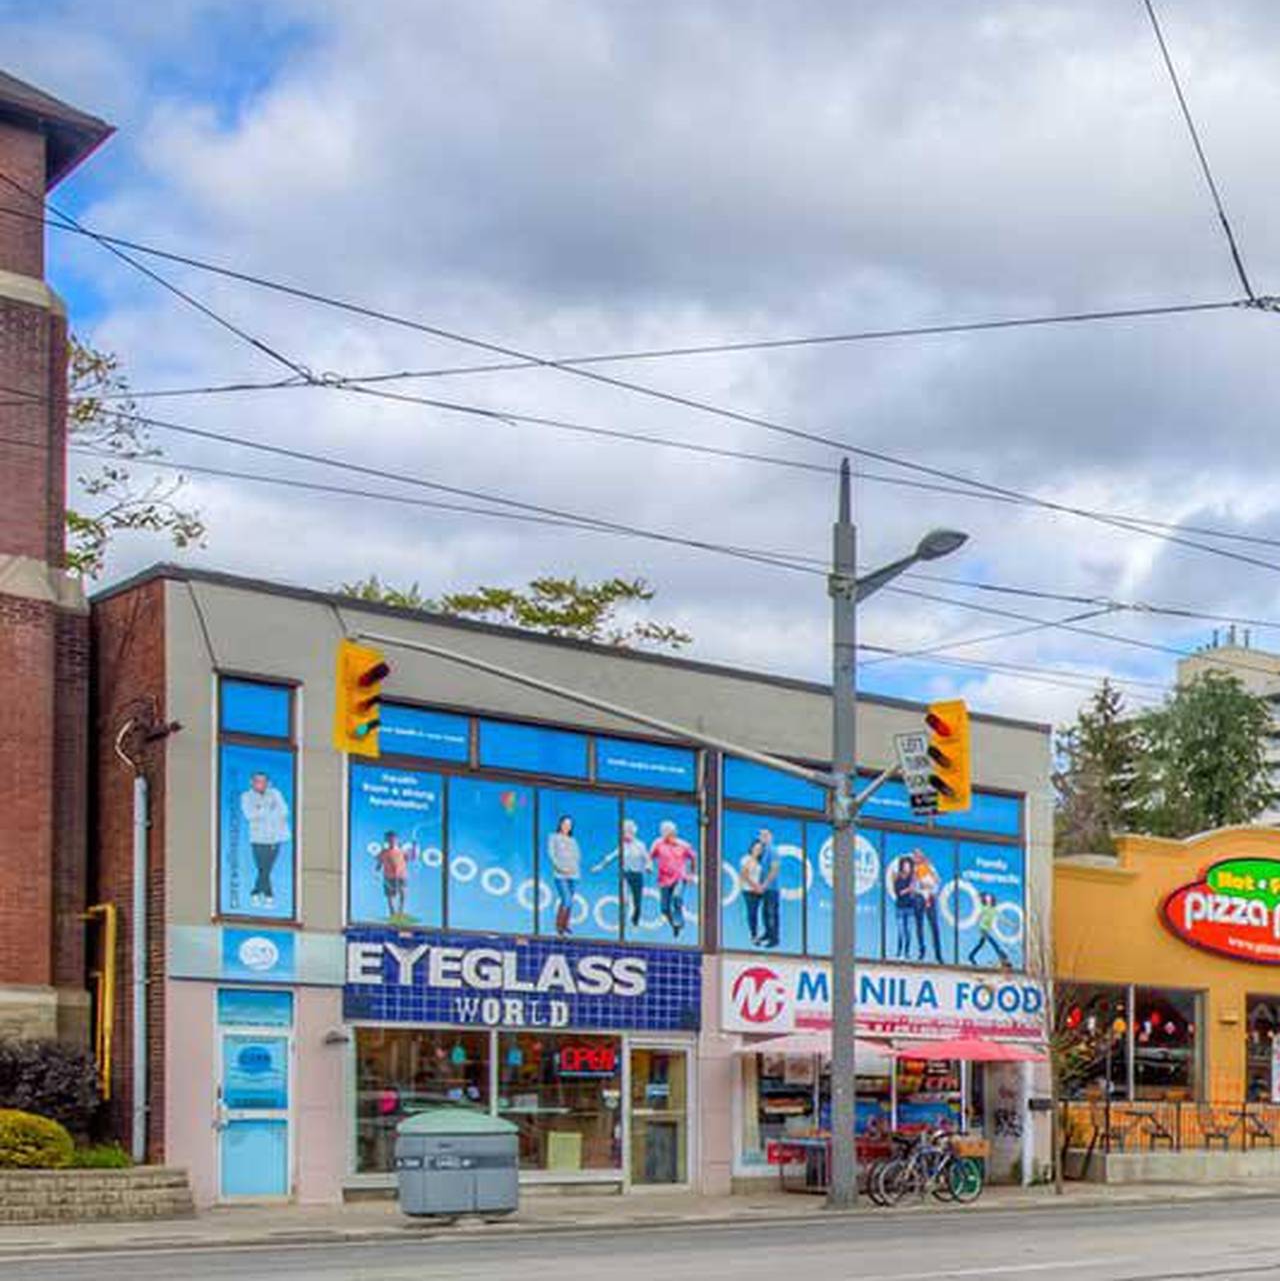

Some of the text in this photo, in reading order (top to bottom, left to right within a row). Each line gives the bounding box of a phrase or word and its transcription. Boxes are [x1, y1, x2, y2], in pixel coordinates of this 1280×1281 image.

[1218, 871, 1253, 890] Hot
[1184, 892, 1268, 931] pizza
[347, 942, 648, 996] EYEGLASS
[796, 970, 1043, 1013] MNILA FOOD
[456, 997, 569, 1027] WORLD
